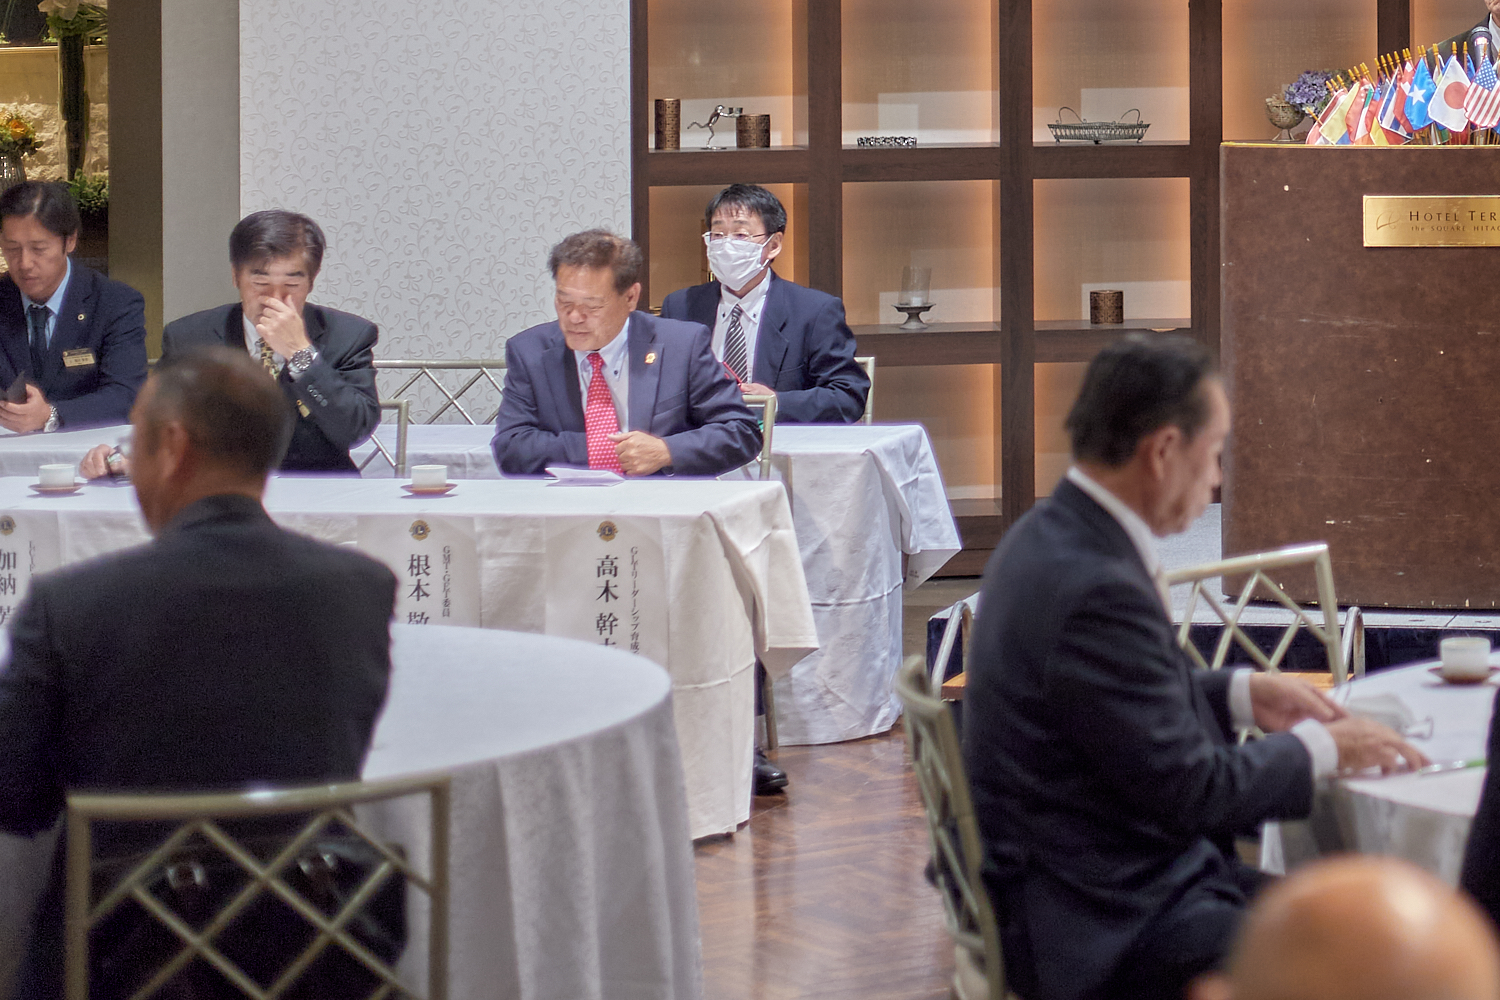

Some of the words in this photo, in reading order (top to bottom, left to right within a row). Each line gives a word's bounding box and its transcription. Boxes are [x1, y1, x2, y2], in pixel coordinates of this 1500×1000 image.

[1409, 210, 1460, 222] HOTEL
[406, 553, 432, 602] 根本
[595, 554, 620, 603] 高木
[630, 546, 640, 654] GLTリーダーシップ育成
